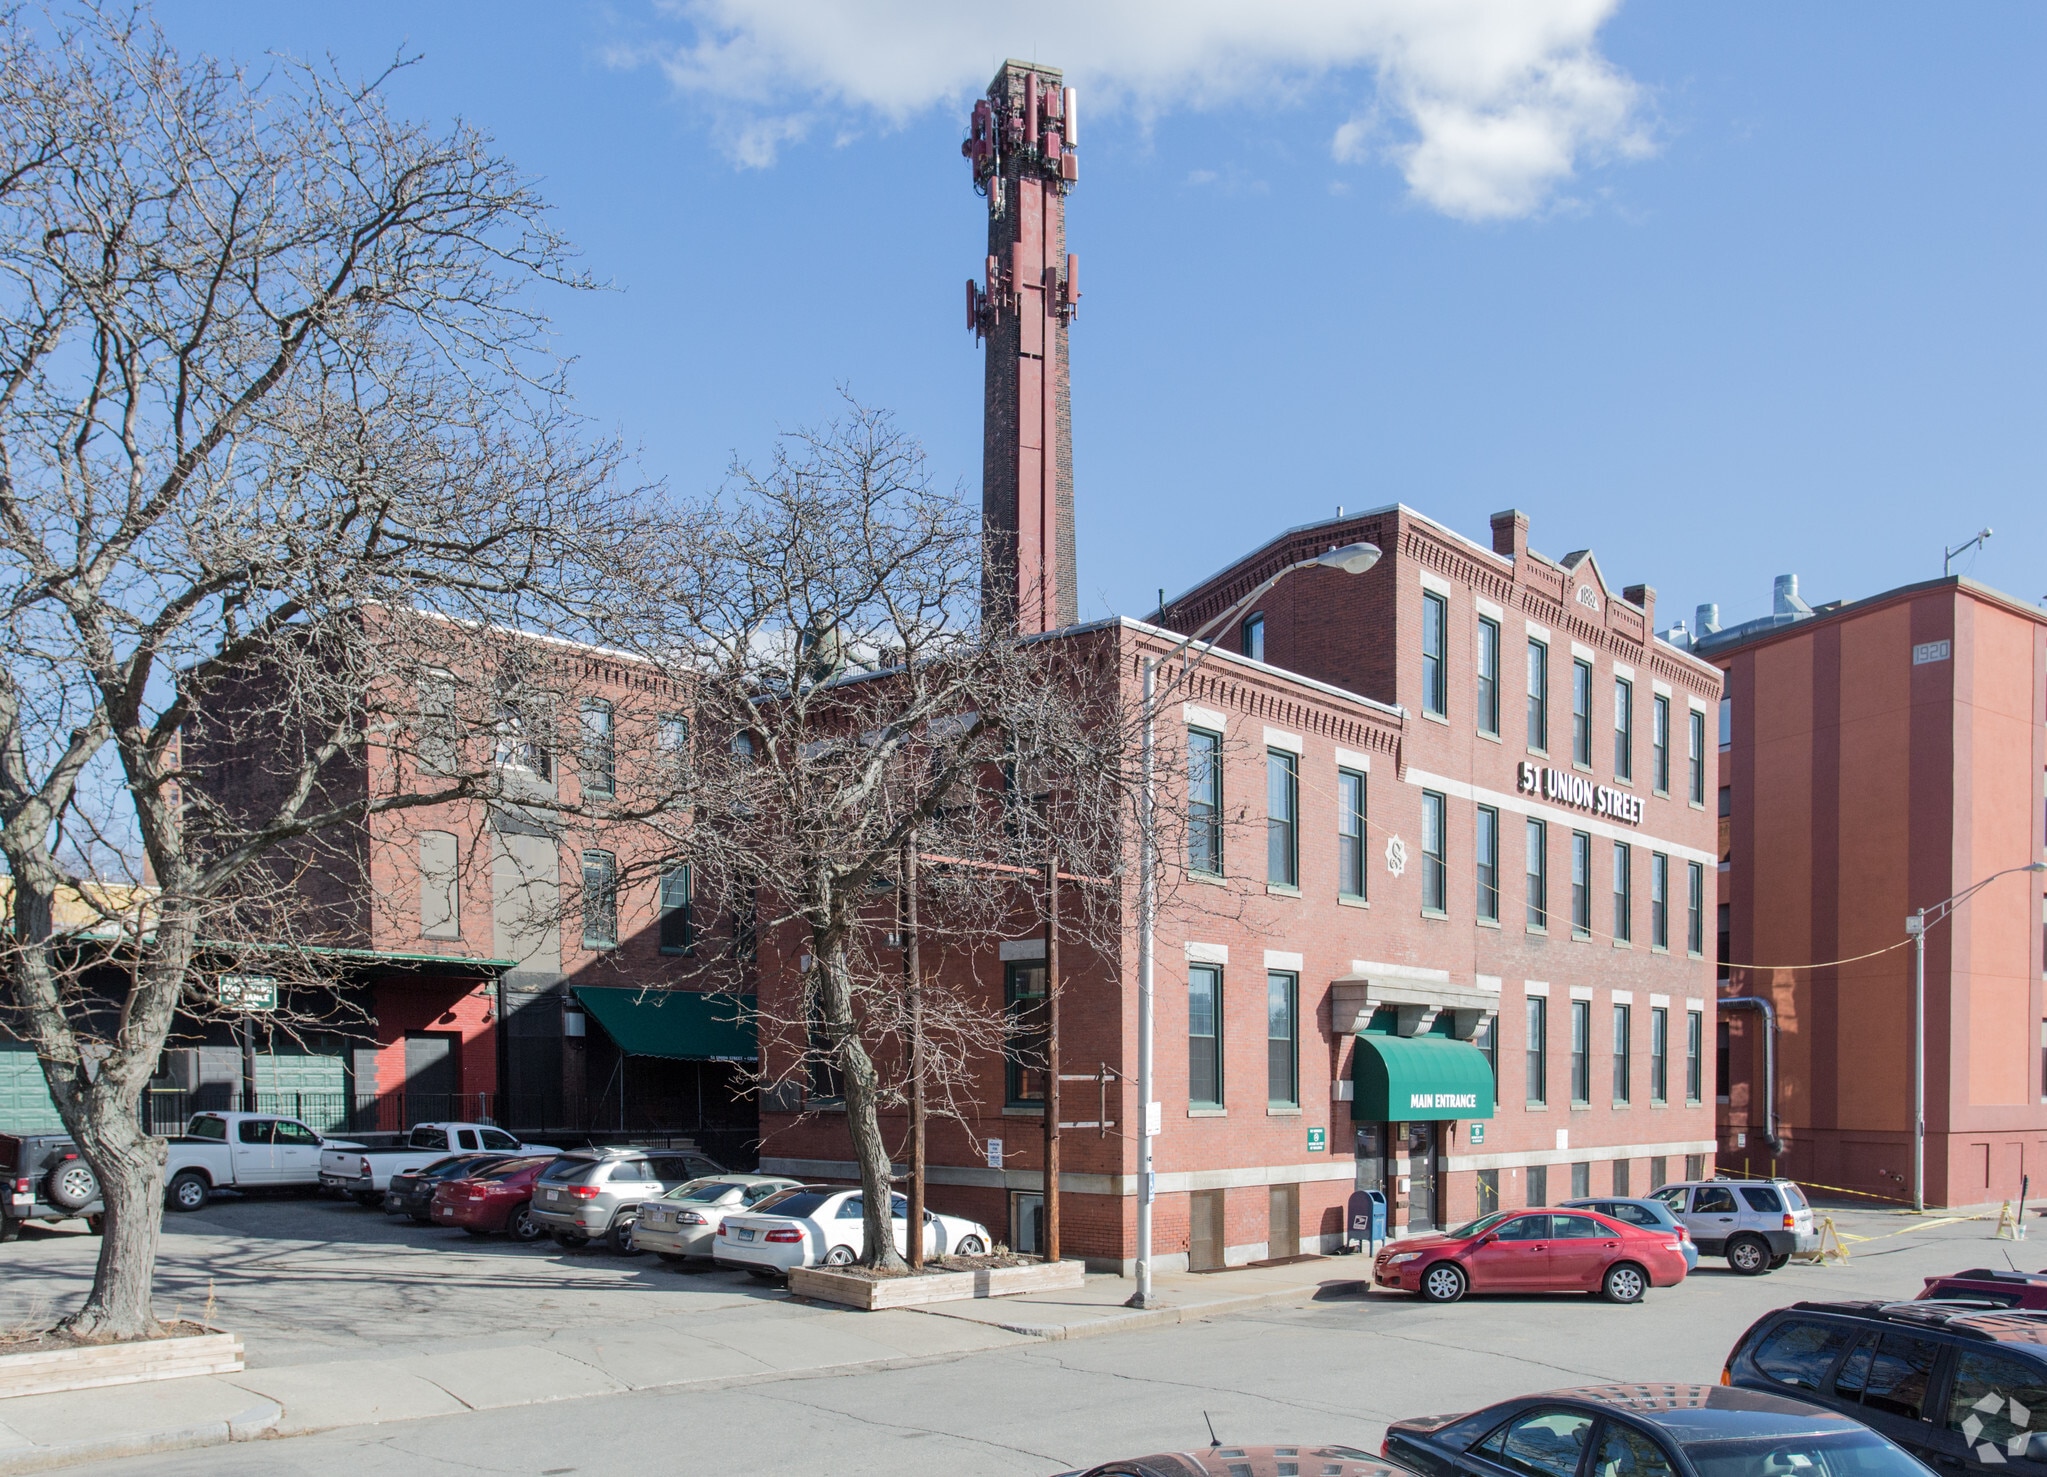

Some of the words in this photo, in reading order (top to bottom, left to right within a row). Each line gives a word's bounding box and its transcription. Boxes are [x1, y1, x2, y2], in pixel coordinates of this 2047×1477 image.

[1915, 642, 1949, 662] 1920
[1521, 761, 1541, 793] 51
[1547, 767, 1594, 808] UNION
[1597, 785, 1646, 824] STREET
[1410, 1093, 1433, 1108] MAIN
[1435, 1093, 1476, 1108] ENTRANCE
